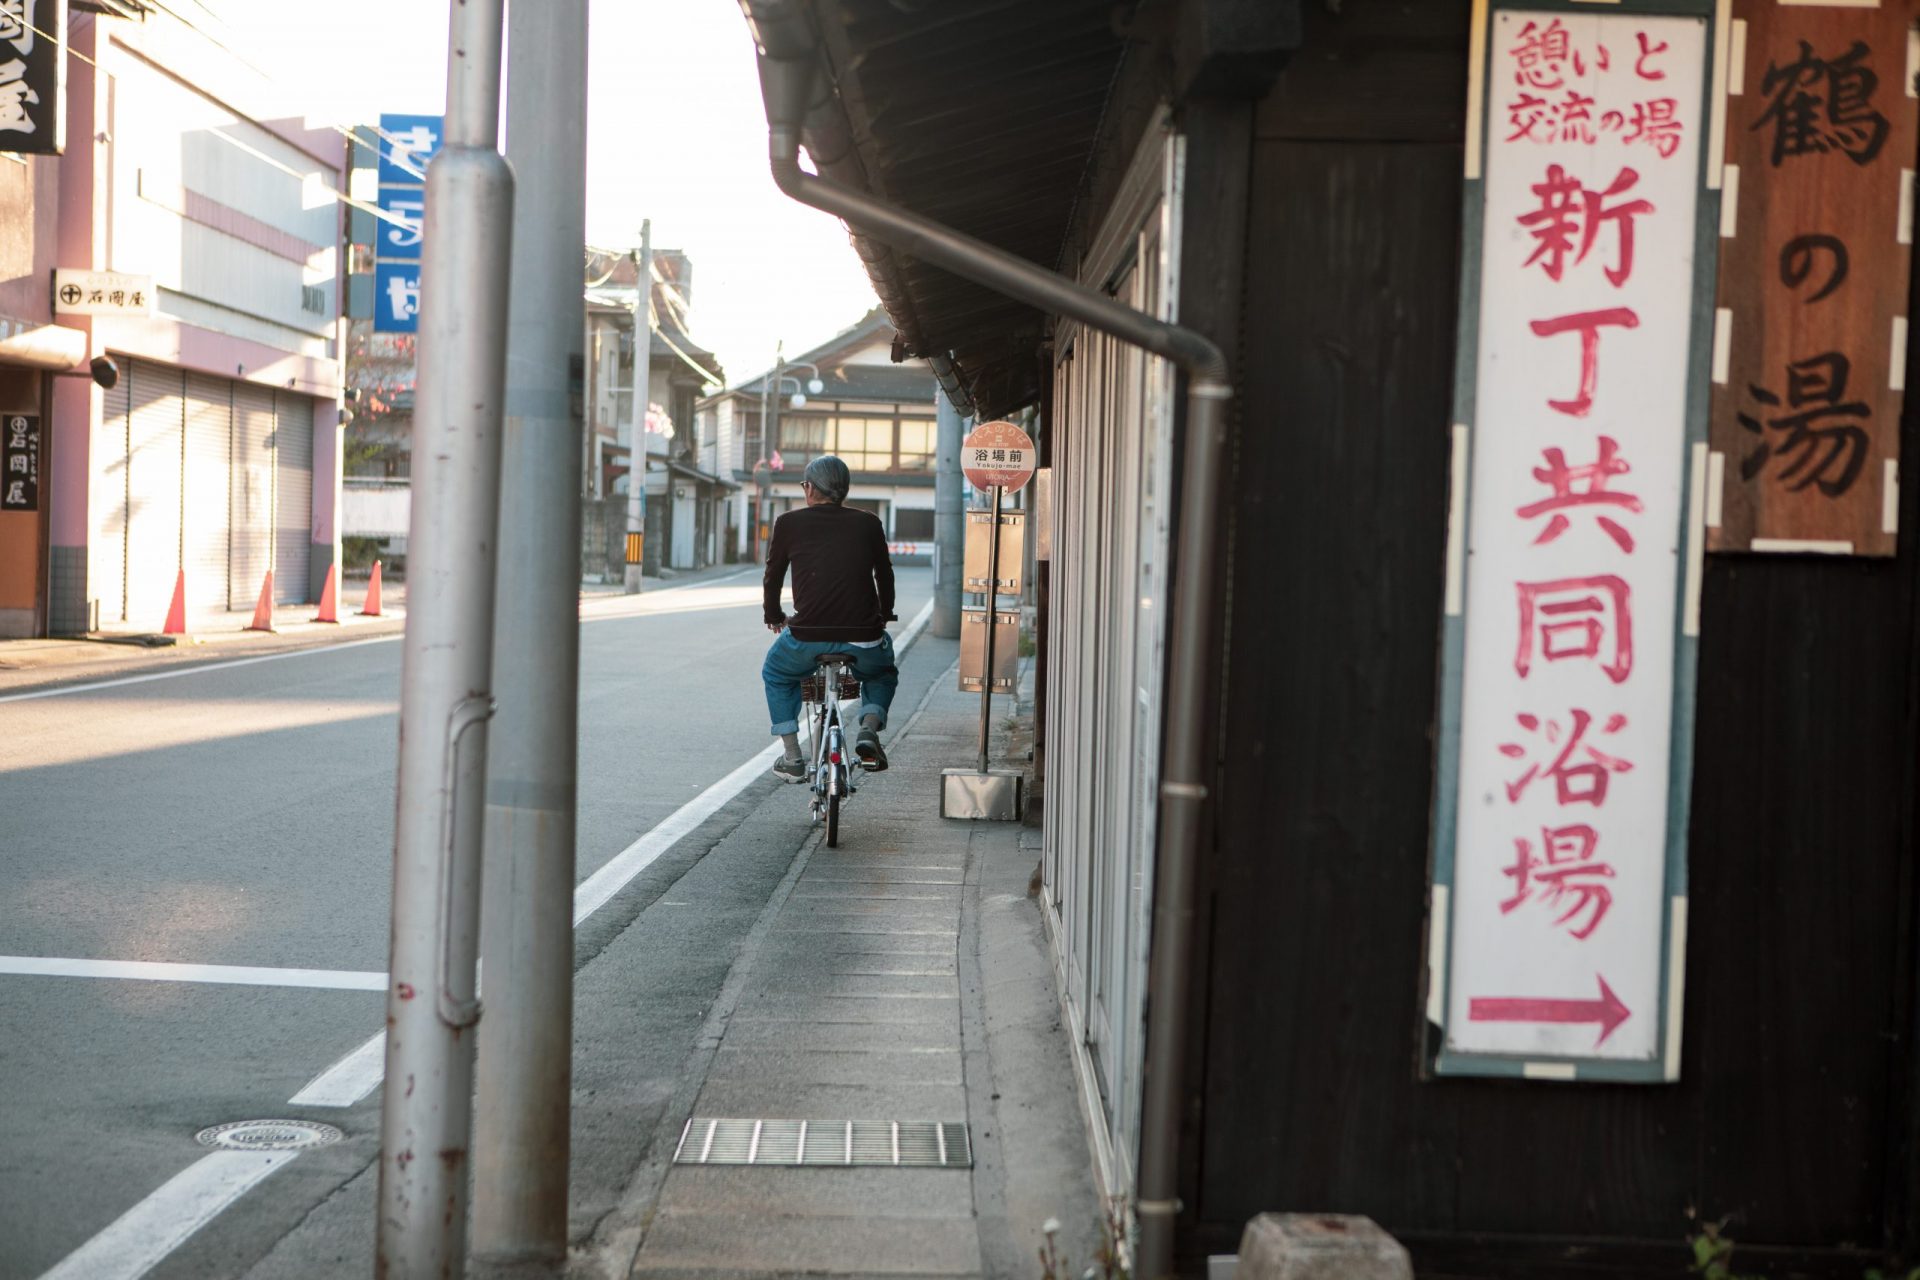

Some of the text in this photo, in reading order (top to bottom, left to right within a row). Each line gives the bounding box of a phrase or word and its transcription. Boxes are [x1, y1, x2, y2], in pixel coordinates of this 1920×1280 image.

[1509, 18, 1669, 90] 憩いと
[1505, 90, 1684, 158] 交流の場
[1737, 38, 1892, 499] 鶴の湯
[975, 449, 1022, 462] 浴場前
[1497, 163, 1657, 940] 新丁共同浴場
